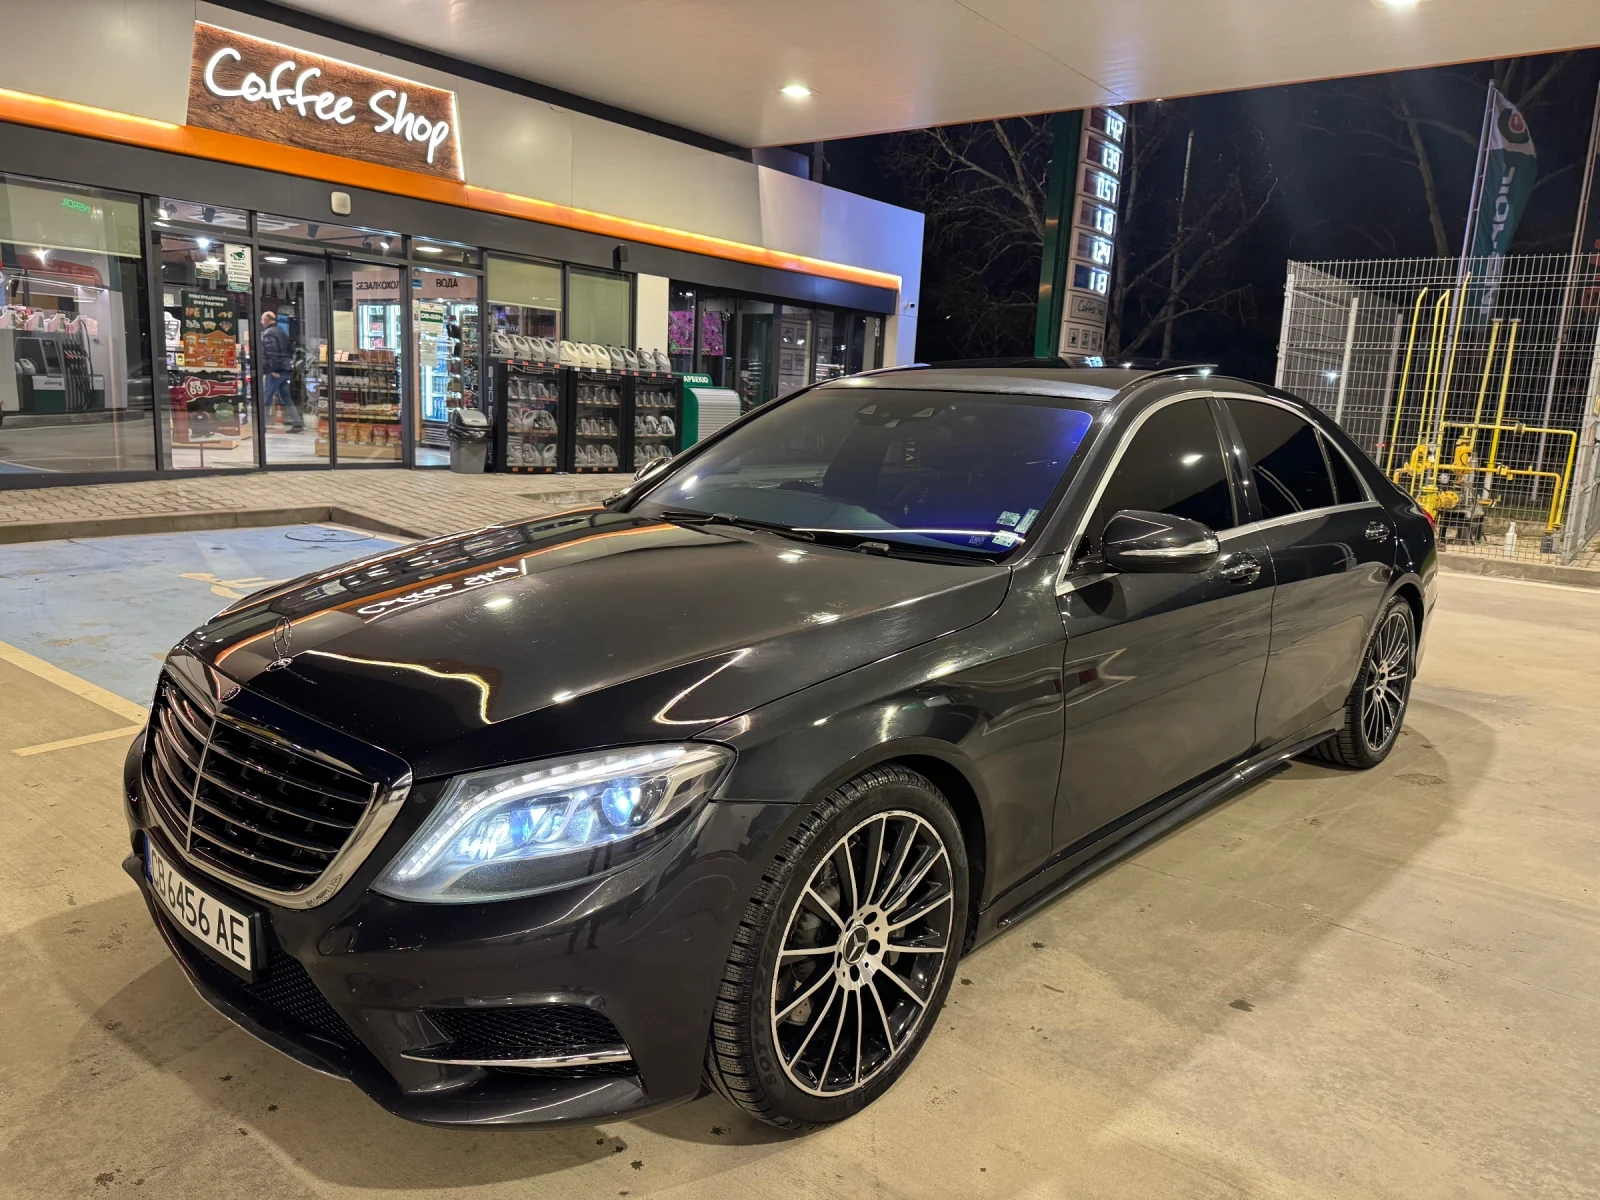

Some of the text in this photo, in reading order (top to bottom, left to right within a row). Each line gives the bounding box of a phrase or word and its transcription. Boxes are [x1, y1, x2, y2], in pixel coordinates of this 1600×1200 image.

[203, 47, 449, 164] Coffee Shop
[435, 278, 459, 288] ВОДА
[683, 375, 709, 384] АРБЕКЮ
[151, 849, 246, 963] CB 6456 AE
